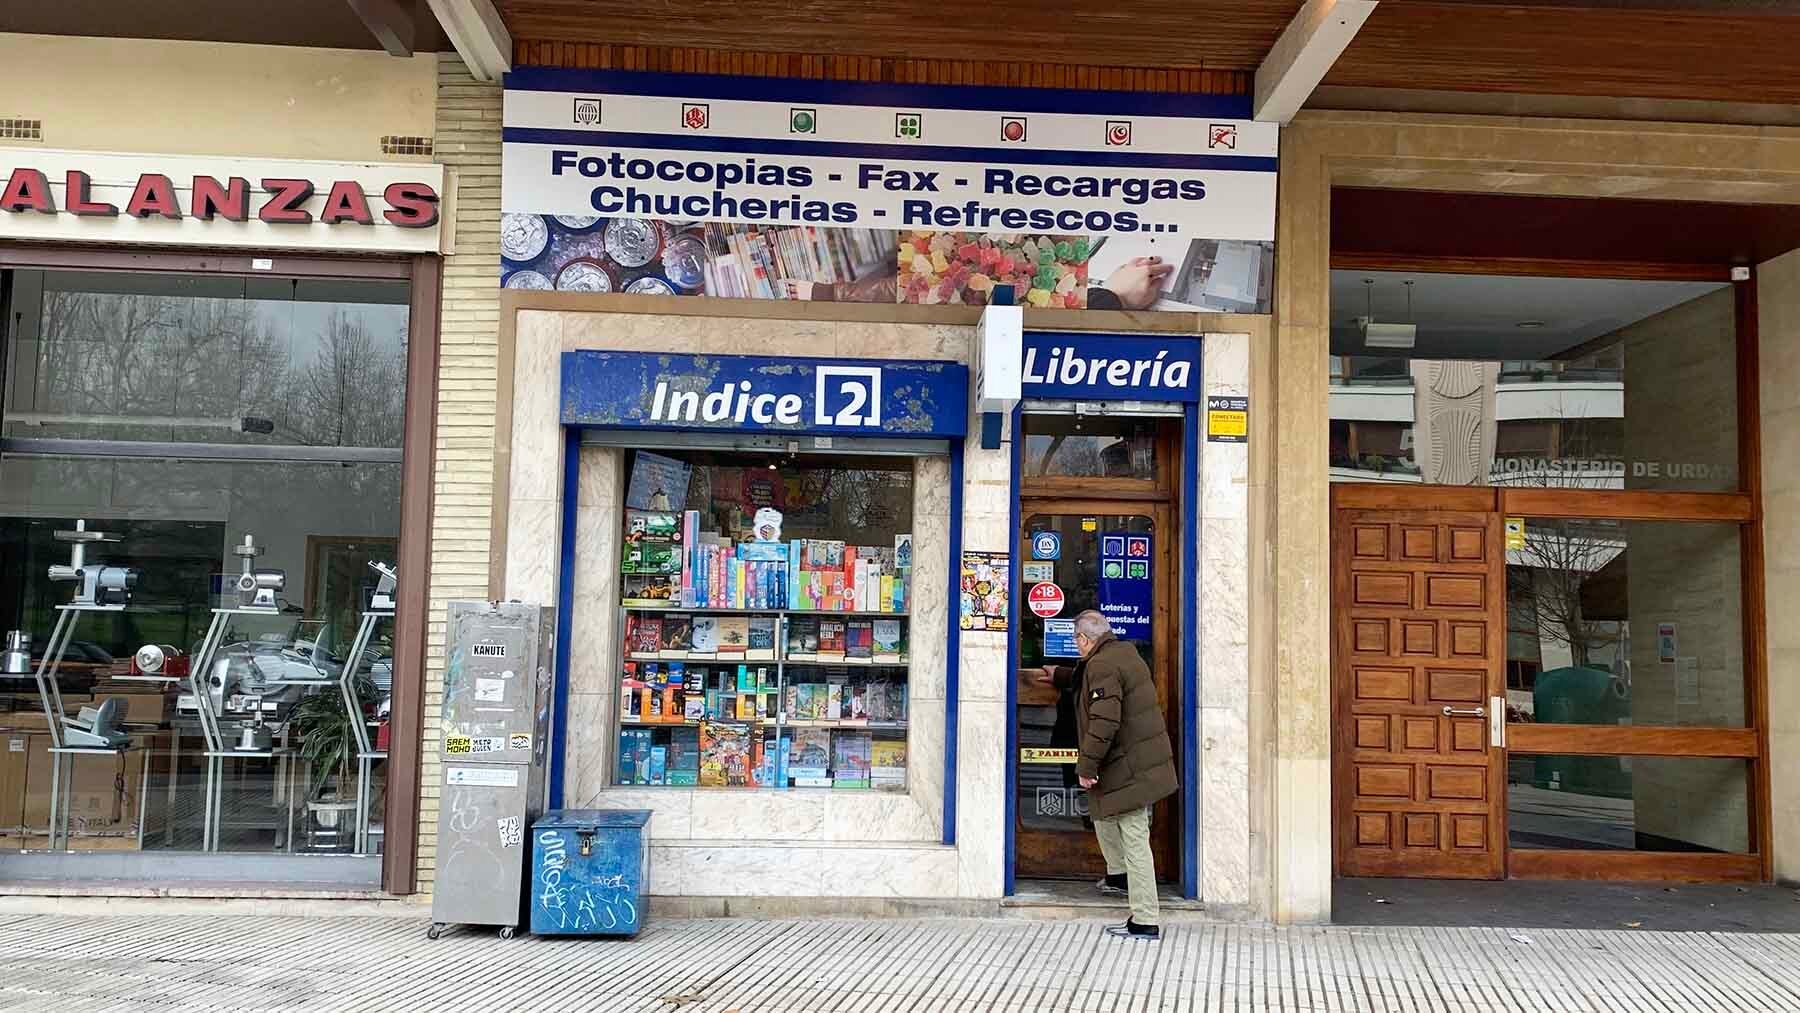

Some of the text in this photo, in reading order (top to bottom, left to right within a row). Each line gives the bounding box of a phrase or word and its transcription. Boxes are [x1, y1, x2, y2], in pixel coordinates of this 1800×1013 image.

[552, 149, 813, 190] Fotocopias
[859, 163, 940, 192] Fax
[984, 168, 1206, 205] Recargas
[0, 168, 439, 227] ALANZAS
[591, 185, 858, 223] Chucherias
[904, 199, 1178, 233] Refrescos...
[1022, 346, 1191, 388] Librería
[650, 380, 802, 425] Indice
[1633, 461, 1661, 477] DE
[1035, 585, 1056, 598] +18
[1100, 603, 1139, 614] Loterías y
[1137, 615, 1150, 624] del
[473, 645, 505, 656] KANUTE
